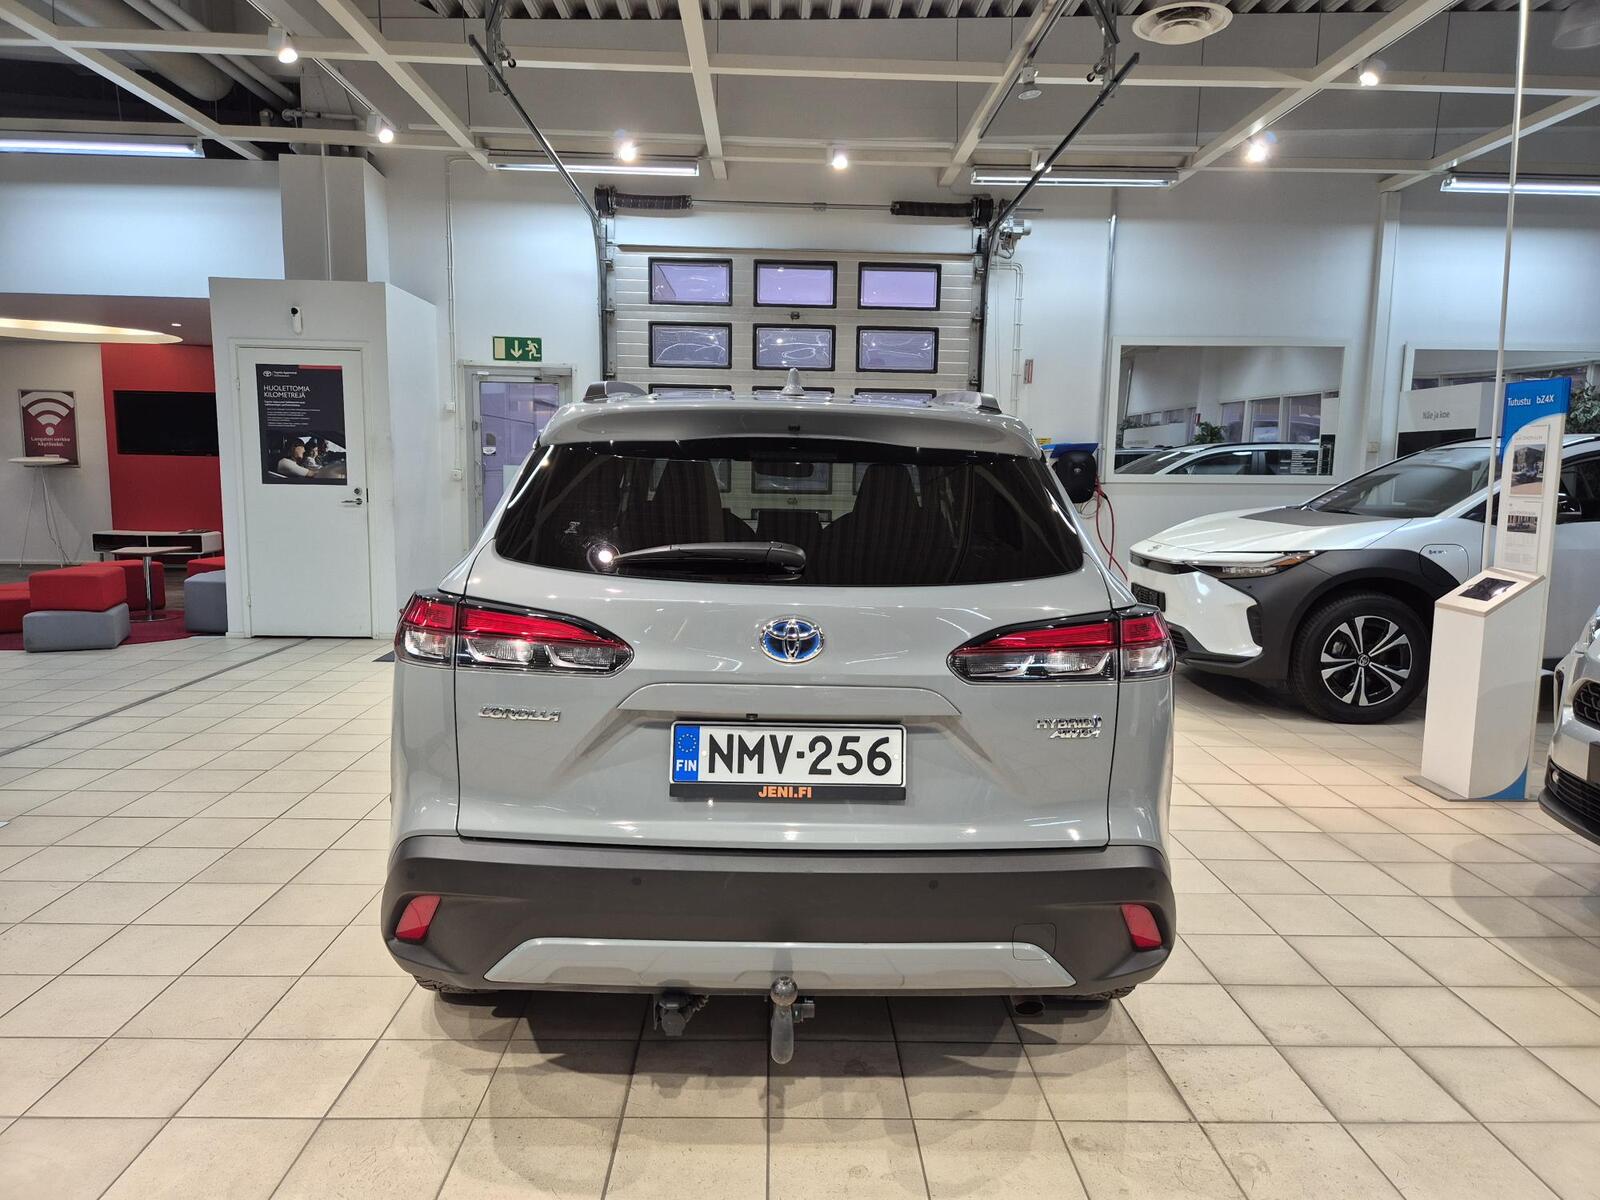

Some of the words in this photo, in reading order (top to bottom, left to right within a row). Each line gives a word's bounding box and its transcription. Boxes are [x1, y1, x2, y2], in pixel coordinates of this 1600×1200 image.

[1507, 397, 1531, 407] Tutustu
[1536, 394, 1554, 404] bZ4X
[478, 705, 561, 722] COROLLA
[1036, 717, 1095, 729] HYBRID
[708, 733, 893, 777] NMV-256
[676, 759, 697, 772] FIN
[758, 785, 812, 799] JENI.FI
